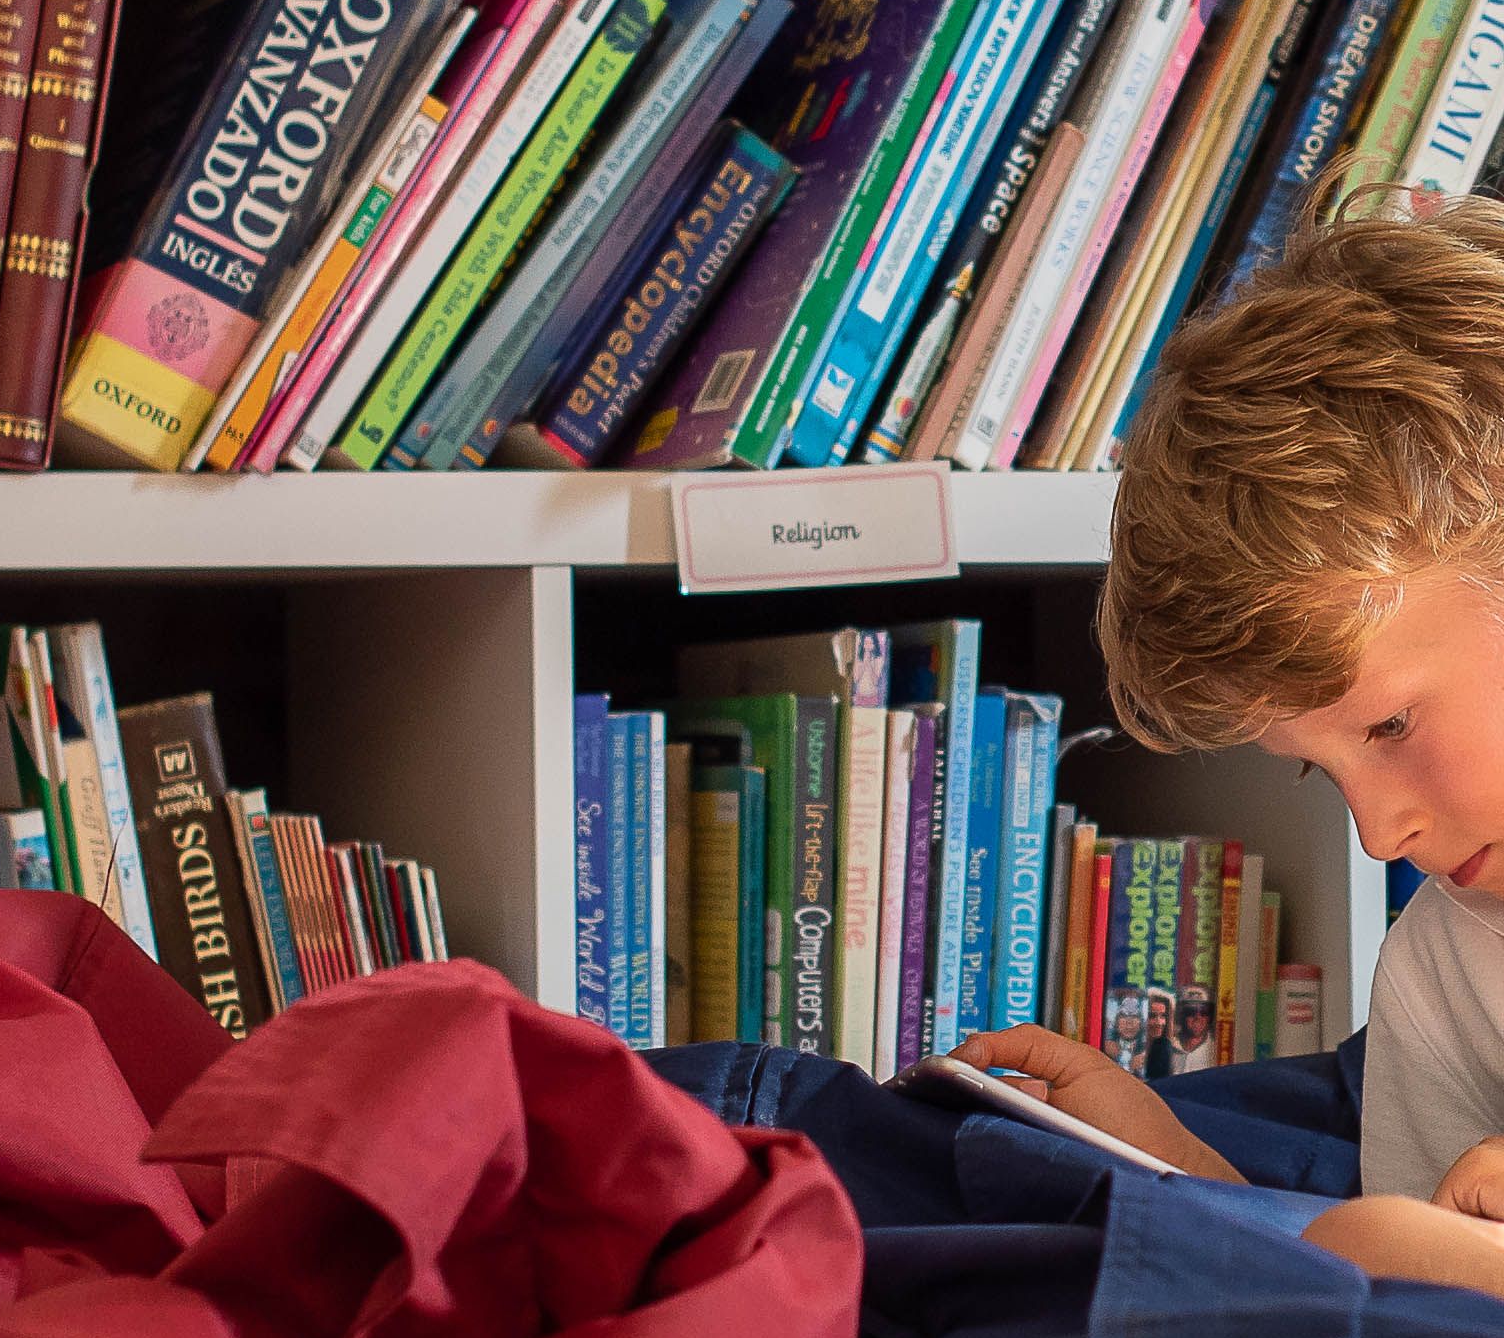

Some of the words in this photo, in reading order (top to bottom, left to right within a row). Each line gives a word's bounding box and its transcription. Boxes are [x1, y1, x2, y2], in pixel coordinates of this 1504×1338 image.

[1025, 47, 1083, 133] Answers
[1320, 10, 1386, 102] DREAM
[1286, 98, 1345, 181] SNOW
[157, 221, 262, 302] INGLÉS
[691, 200, 760, 287] OXFORD
[566, 159, 751, 418] Encyclopedia
[89, 371, 184, 441] OXFORD
[771, 521, 860, 550] Religion
[804, 717, 825, 798] Usborne
[932, 749, 945, 777] TAJ
[574, 799, 603, 839] See
[930, 782, 943, 840] MAHAL
[172, 822, 232, 963] BIRDS
[574, 843, 603, 901] inside
[943, 860, 962, 932] PICTURE
[966, 846, 988, 880] See
[843, 863, 874, 949] mine
[962, 884, 987, 945] inside
[1121, 842, 1156, 989] Explorer
[1148, 842, 1183, 990] Explorer
[1186, 842, 1223, 987] Explorer
[576, 907, 609, 994] World
[629, 950, 652, 1033] WORLD
[790, 903, 828, 1032] Computers
[940, 938, 957, 994] ATLAS
[955, 947, 982, 1018] Planet
[607, 956, 631, 1039] WORLD
